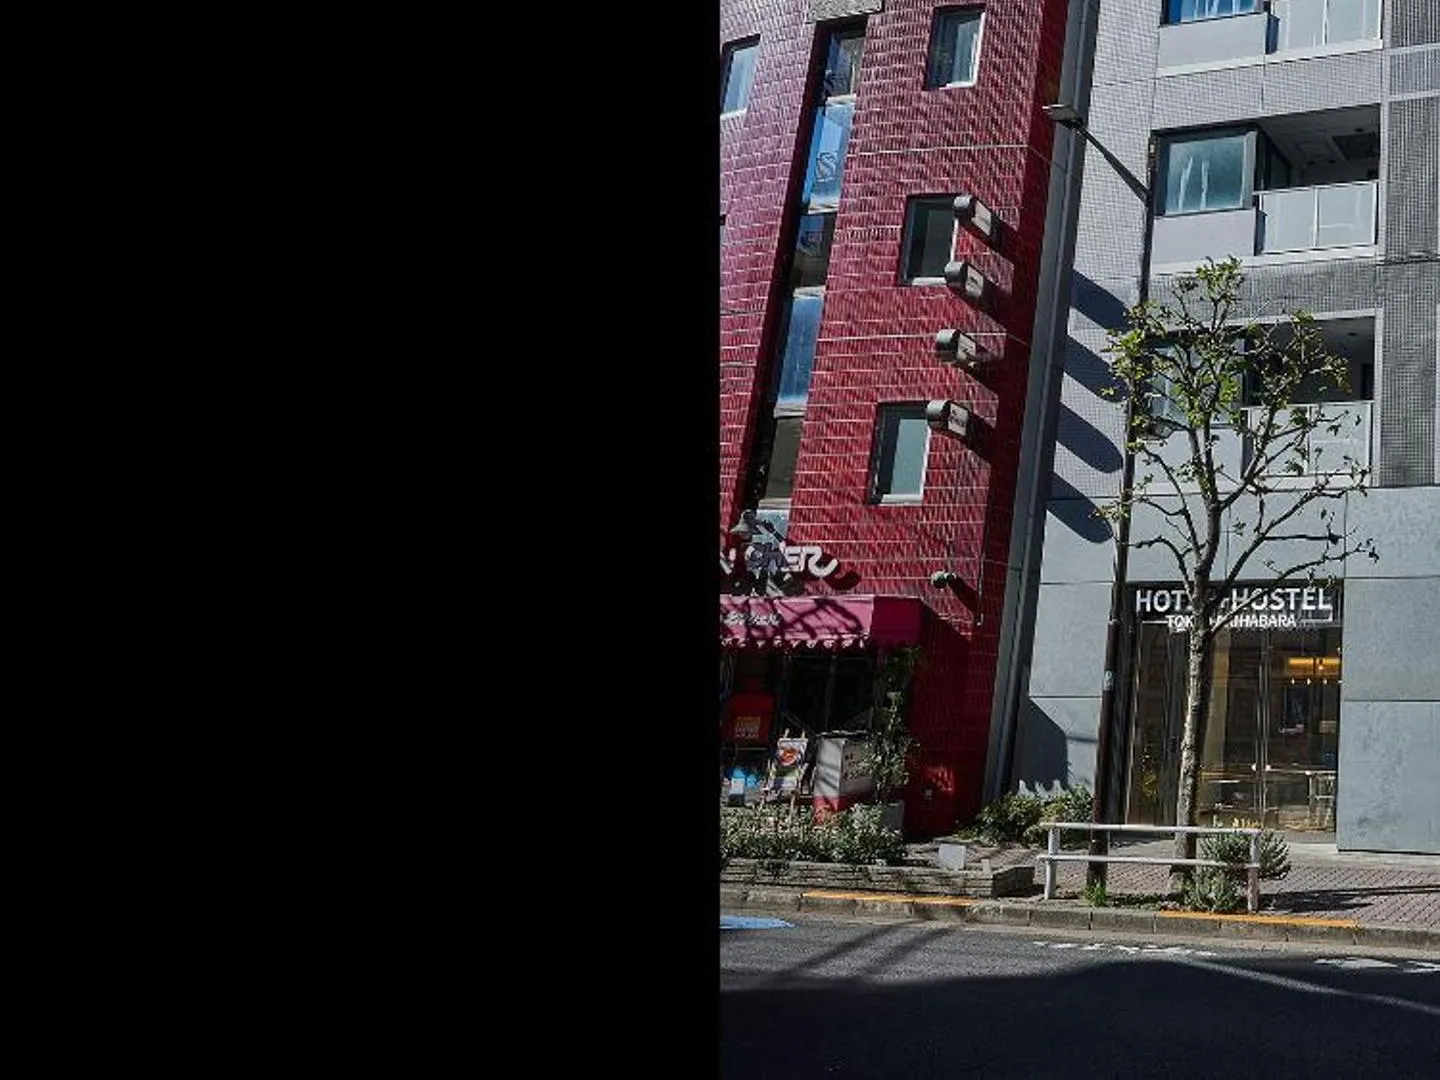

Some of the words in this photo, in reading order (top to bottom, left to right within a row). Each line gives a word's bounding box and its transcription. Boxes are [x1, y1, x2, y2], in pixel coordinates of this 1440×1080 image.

[1135, 589, 1204, 612] HOT
[1231, 587, 1330, 611] HOSTEL
[1165, 614, 1213, 628] TOK
